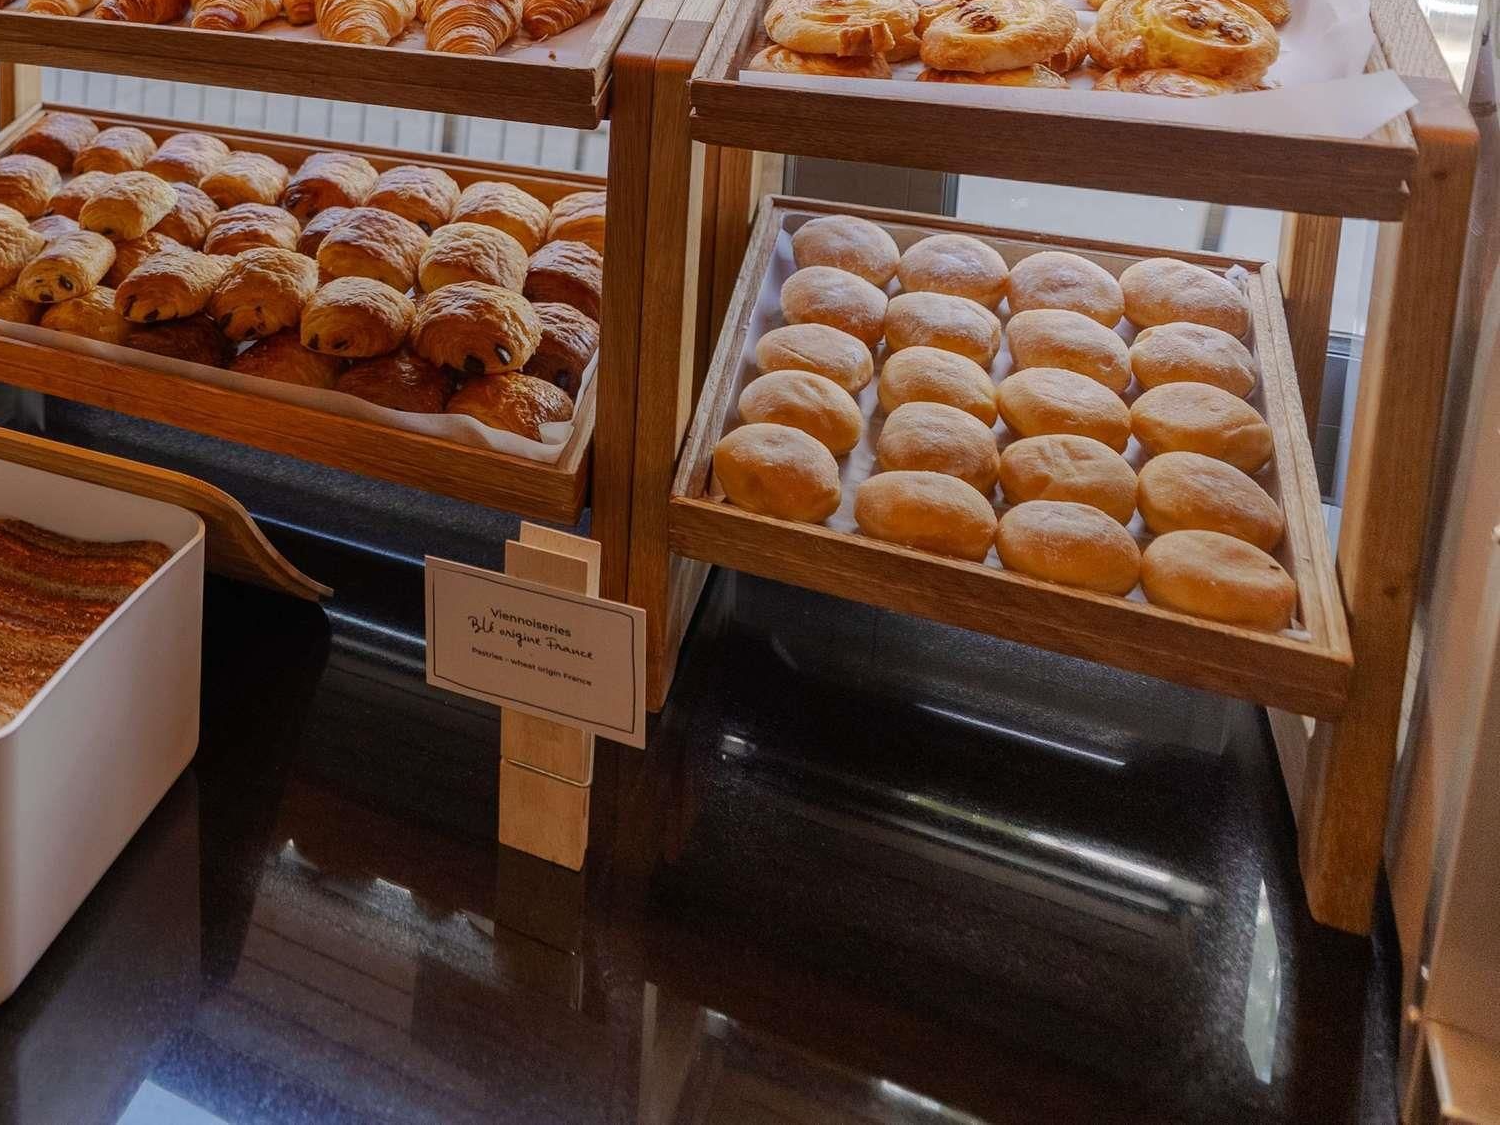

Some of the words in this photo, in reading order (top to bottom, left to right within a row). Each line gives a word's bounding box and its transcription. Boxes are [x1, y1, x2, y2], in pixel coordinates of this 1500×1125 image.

[489, 607, 572, 637] Viennoiseries
[499, 628, 542, 648] origine
[545, 637, 594, 659] France
[471, 646, 504, 662] Pastries
[537, 665, 562, 678] origin
[563, 672, 592, 687] France
